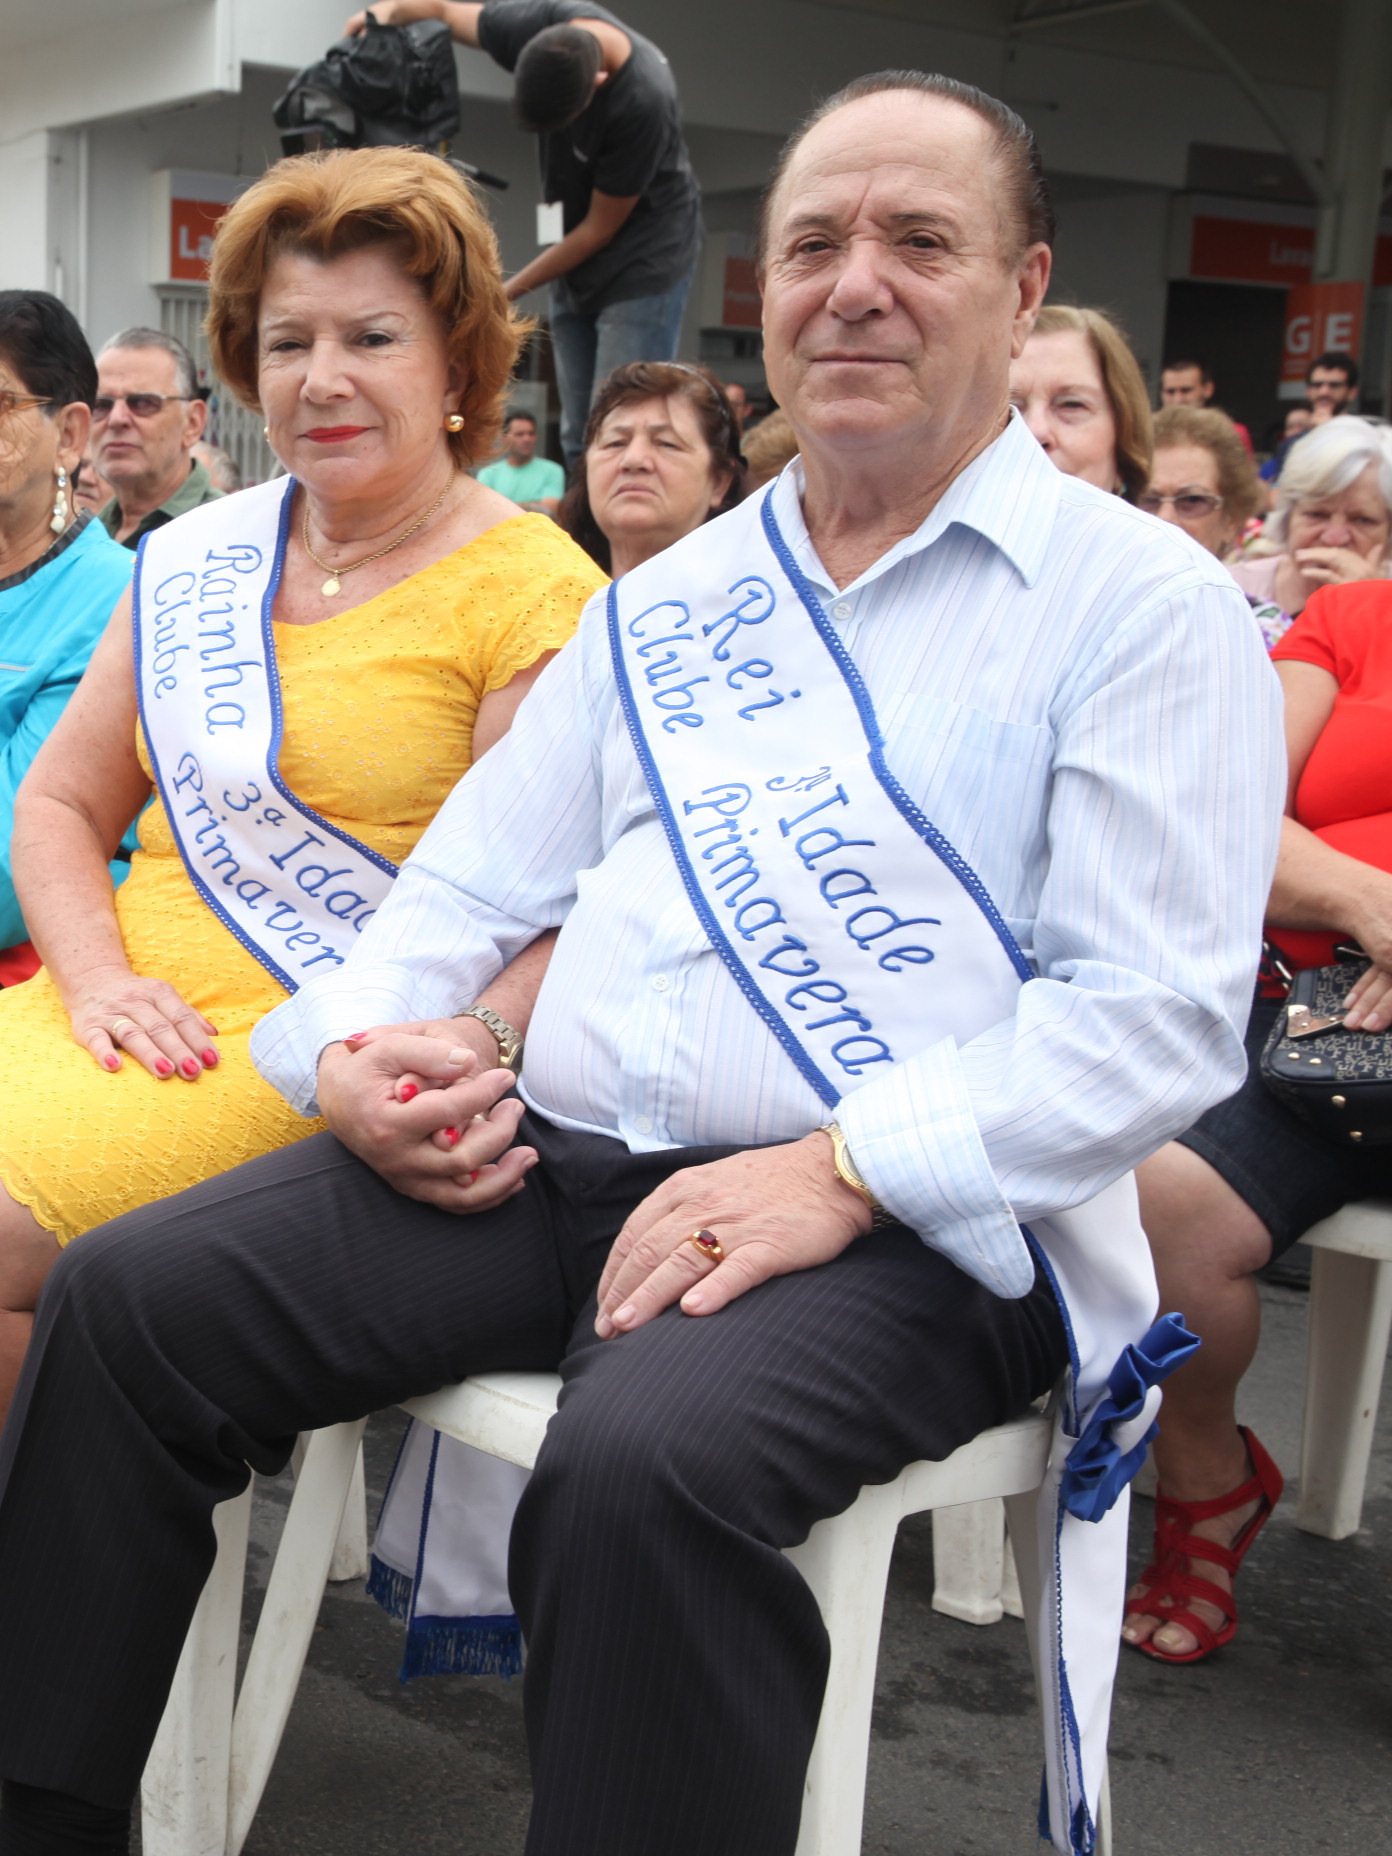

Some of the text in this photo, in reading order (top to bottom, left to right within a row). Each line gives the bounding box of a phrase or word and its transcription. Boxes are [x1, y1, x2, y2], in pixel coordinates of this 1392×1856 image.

[153, 571, 196, 698] Clube
[198, 545, 262, 735] Rainha
[702, 575, 802, 722] Rei
[778, 784, 941, 972] Idade
[628, 599, 894, 1075] Clube Primavera
